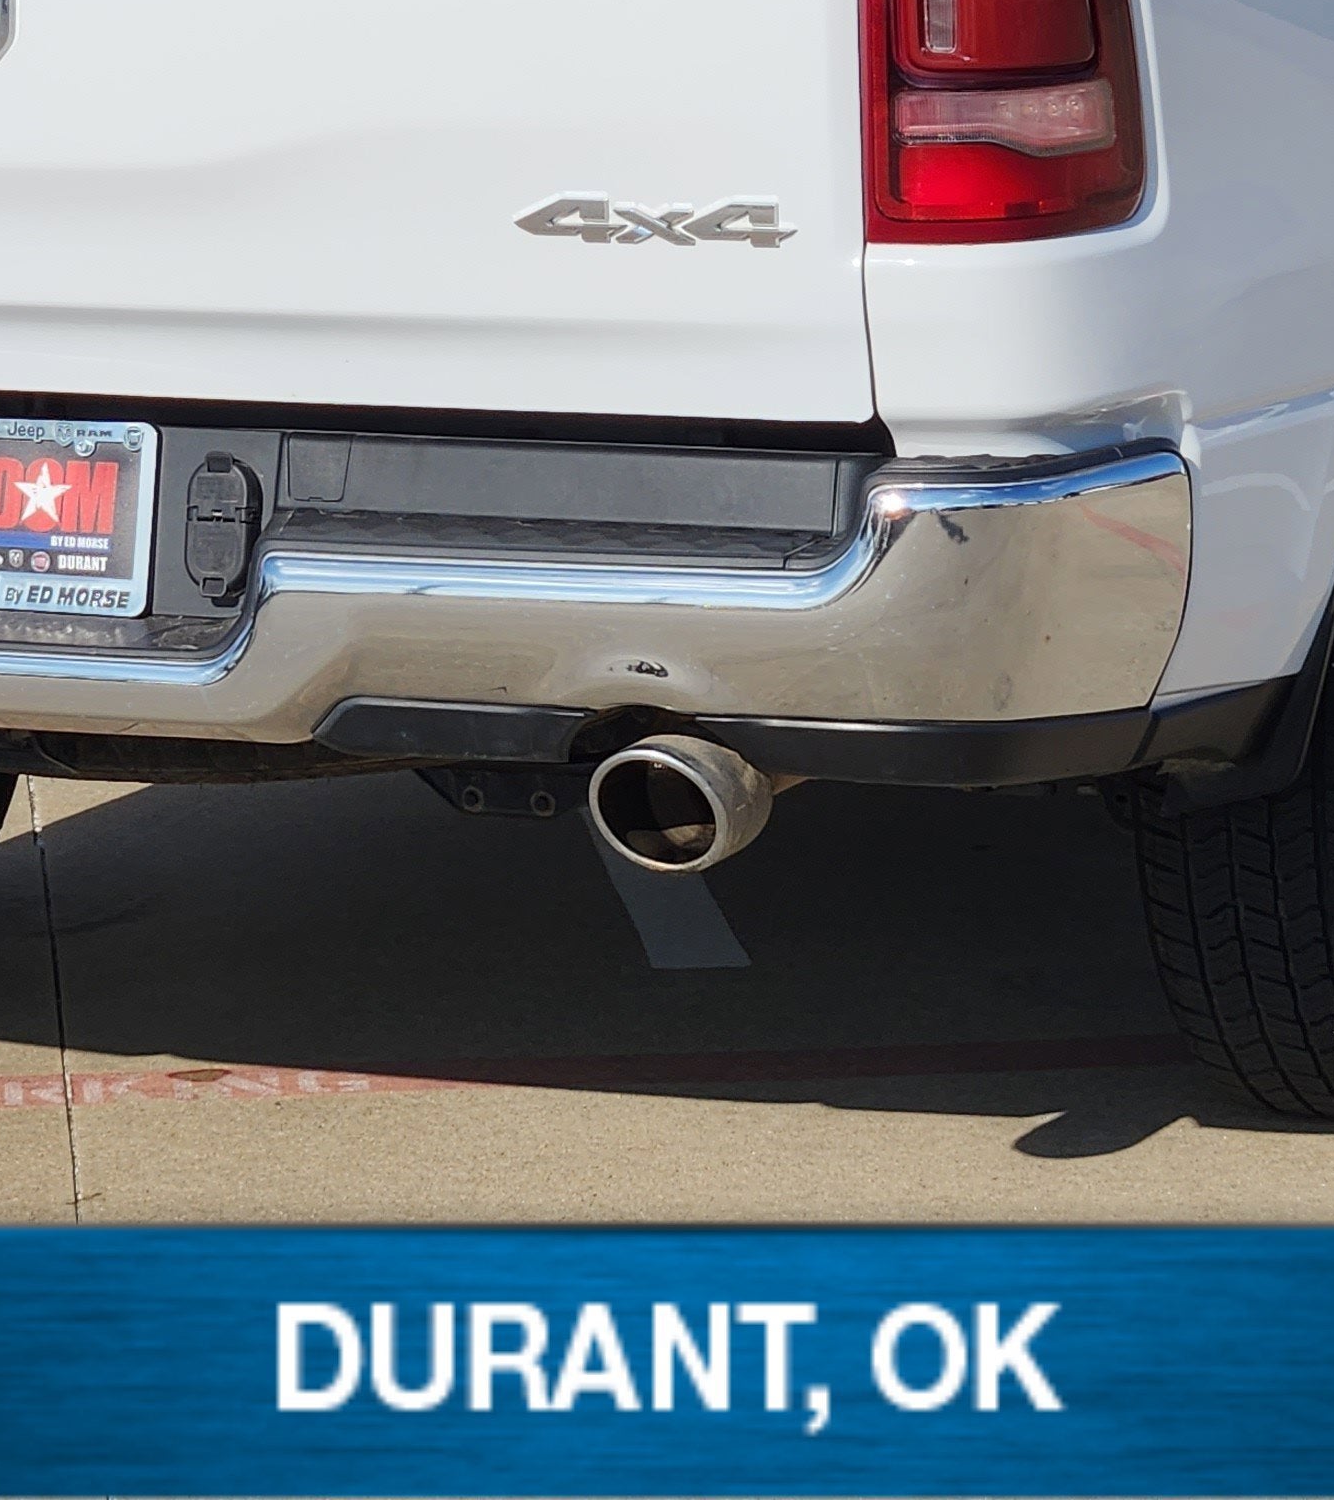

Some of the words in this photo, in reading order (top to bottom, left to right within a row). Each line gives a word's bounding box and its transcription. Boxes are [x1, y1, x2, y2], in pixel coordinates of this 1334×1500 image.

[7, 421, 46, 440] Jeep
[76, 429, 113, 438] RAM
[50, 535, 63, 547] BY
[64, 536, 76, 548] ED
[77, 536, 110, 550] MORSE
[56, 553, 109, 572] DURANT
[26, 585, 54, 604] ED
[56, 585, 131, 609] MORSE
